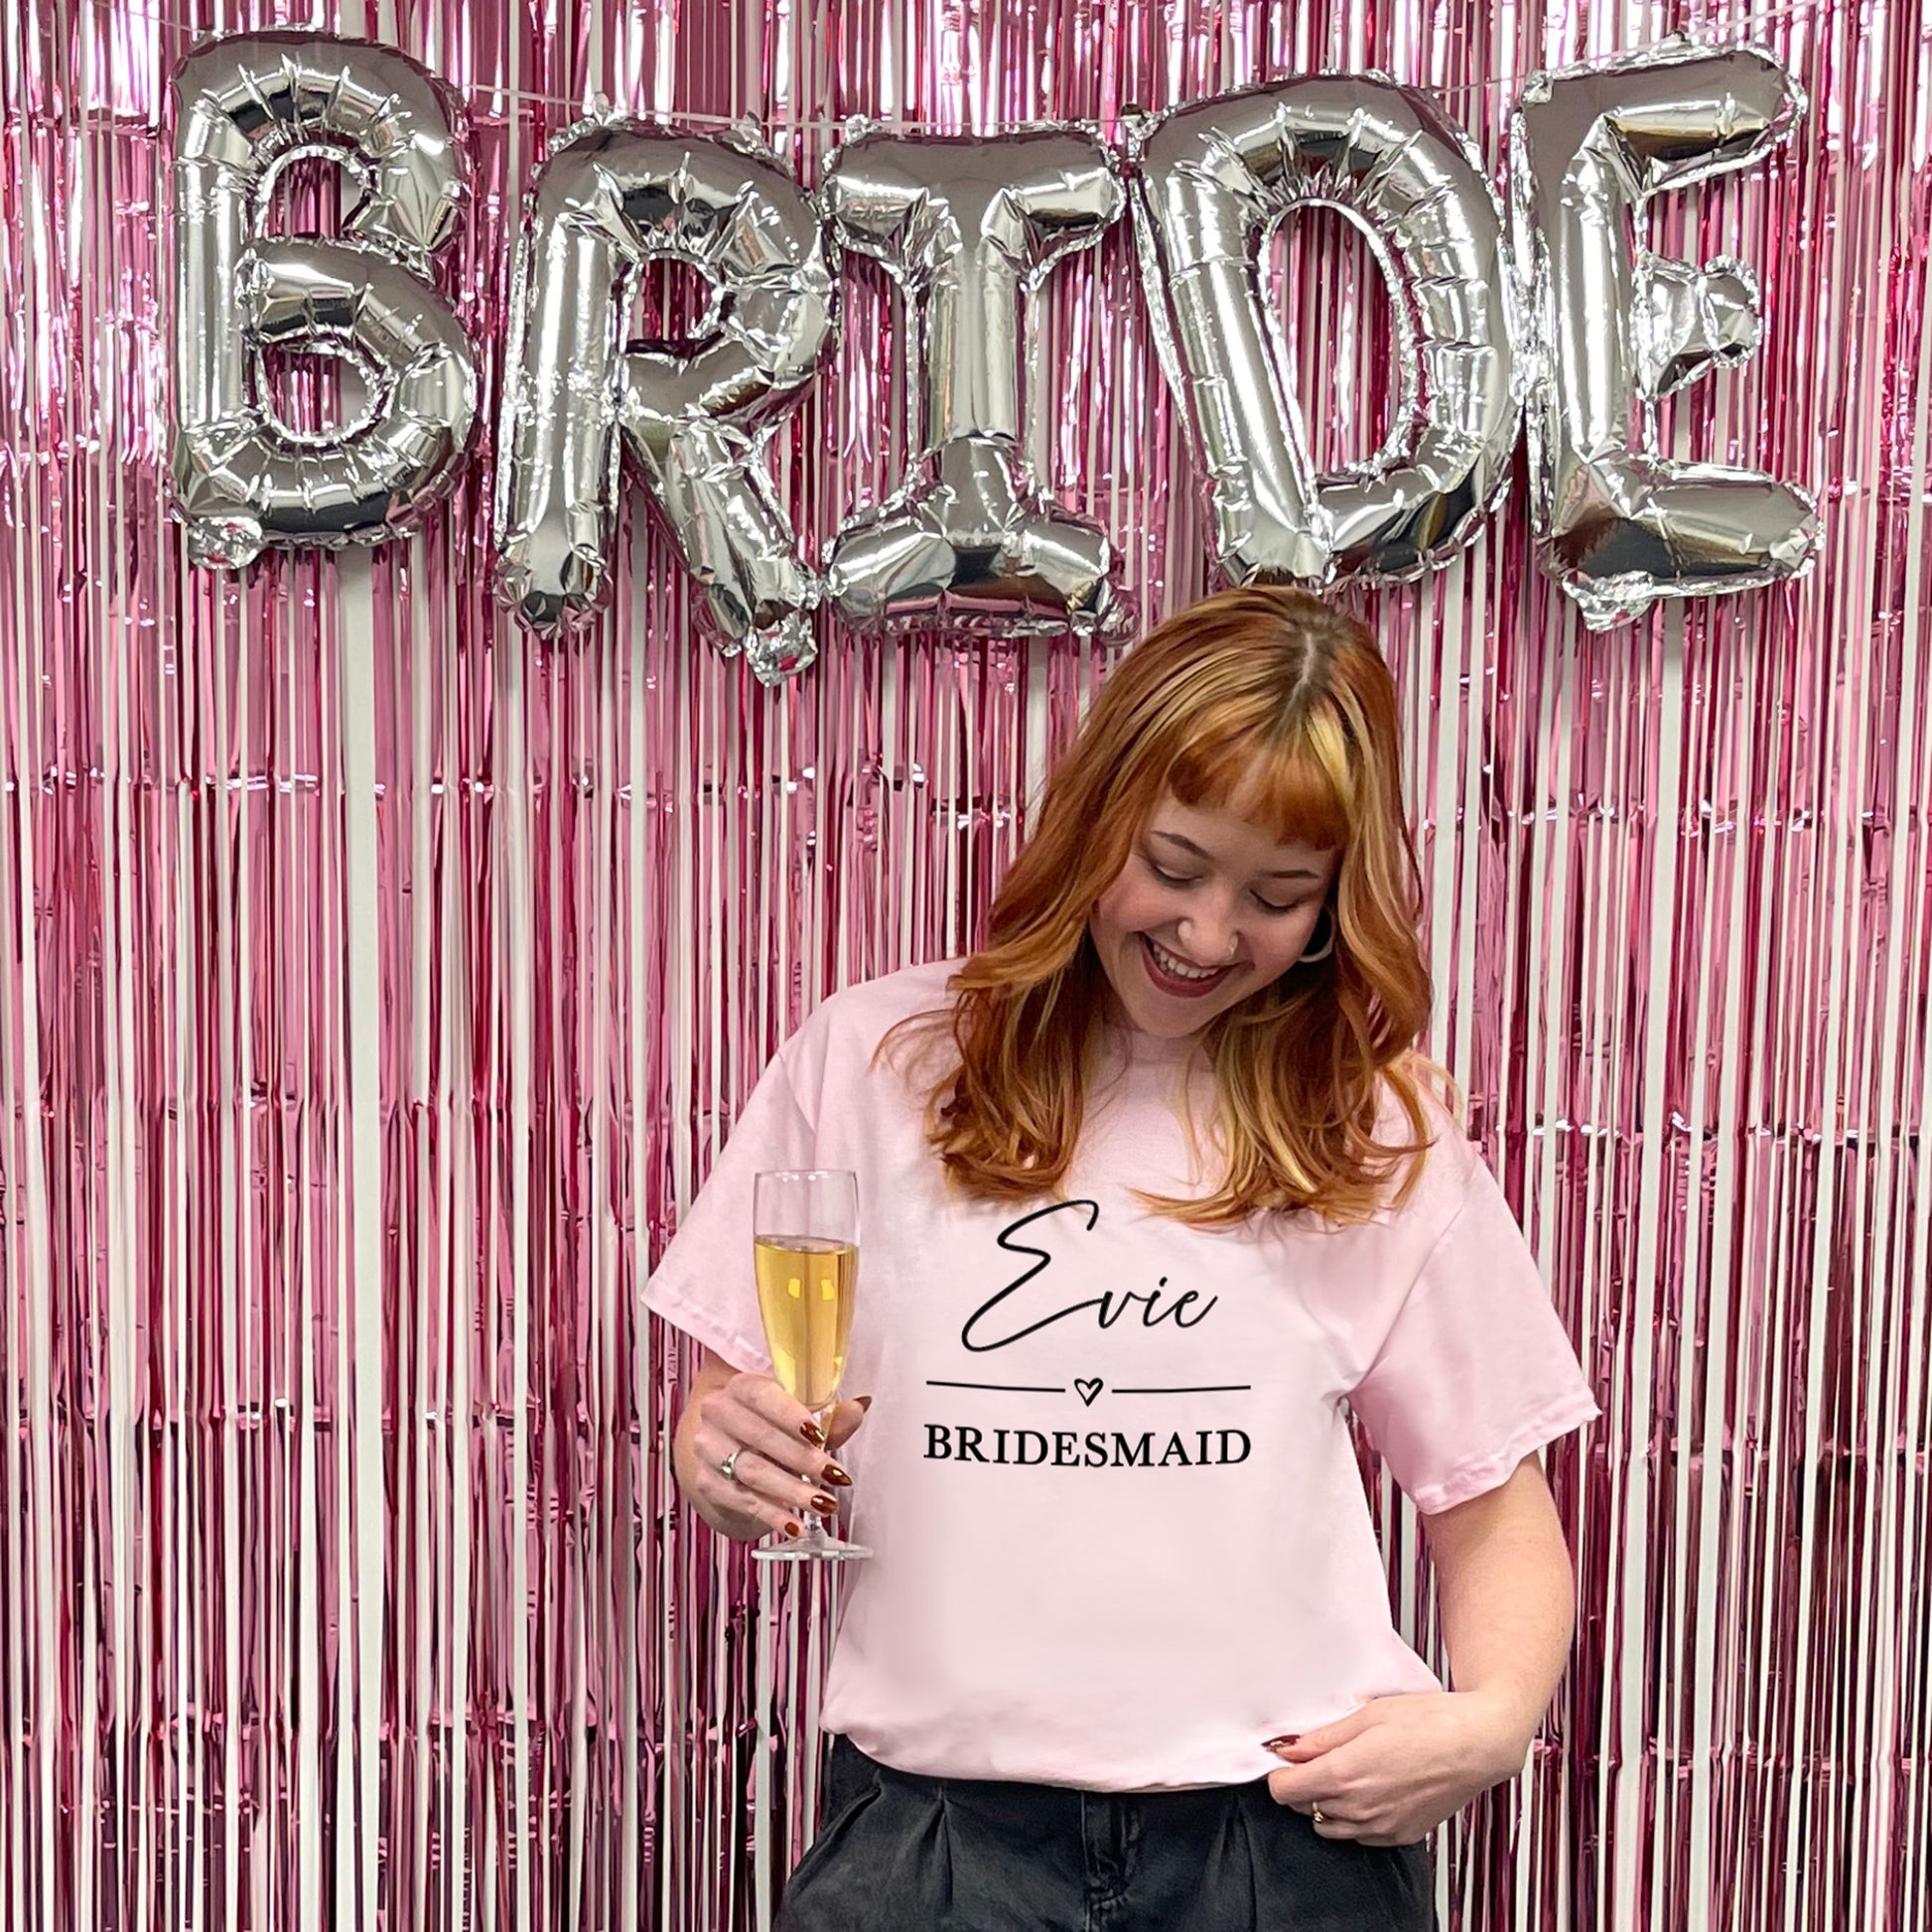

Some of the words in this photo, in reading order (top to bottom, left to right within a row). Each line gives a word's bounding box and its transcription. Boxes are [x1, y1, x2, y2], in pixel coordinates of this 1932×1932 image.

[170, 27, 1825, 686] BRIDE
[961, 1199, 1218, 1352] Evie
[923, 1424, 1251, 1467] BRIDESMAID
